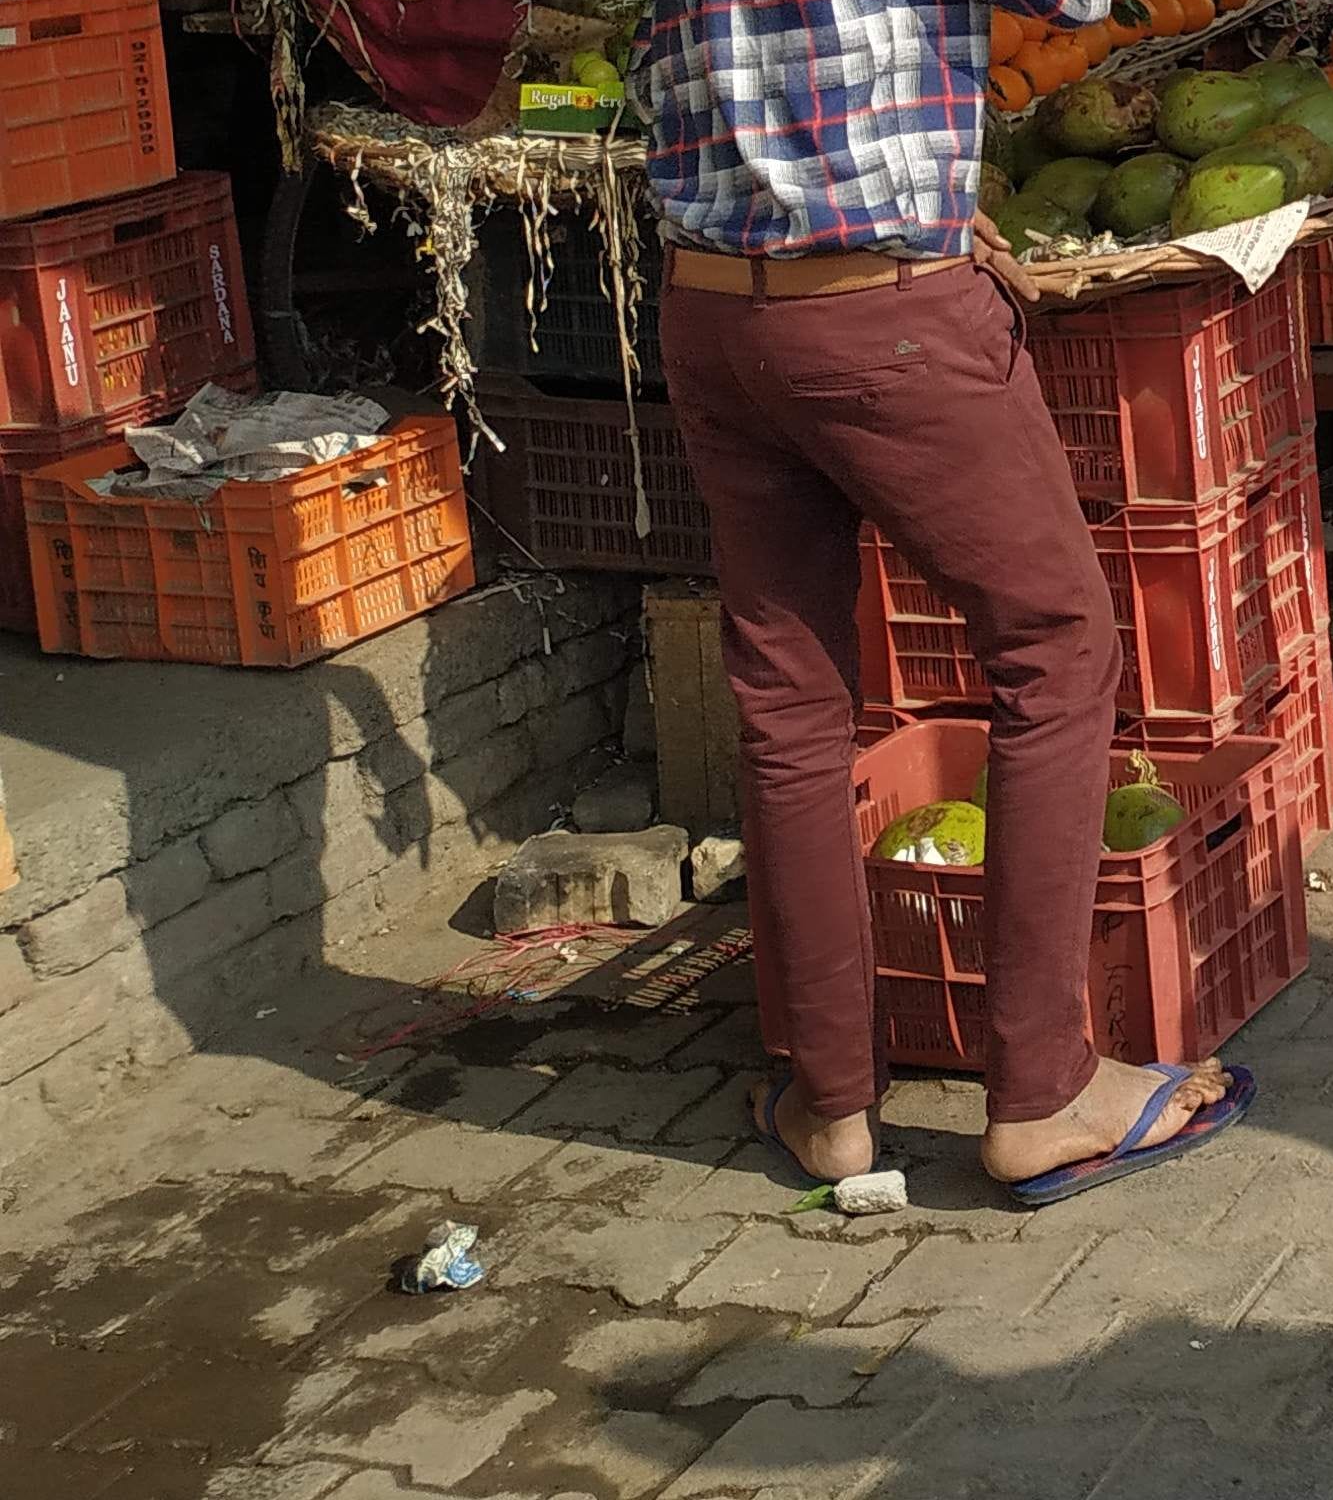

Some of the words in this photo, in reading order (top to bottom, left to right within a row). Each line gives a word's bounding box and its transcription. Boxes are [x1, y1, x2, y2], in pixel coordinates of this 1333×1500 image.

[530, 89, 573, 110] Regal
[56, 278, 79, 387] JAANU
[209, 244, 235, 345] SARDANA
[1192, 344, 1207, 460] JAANU
